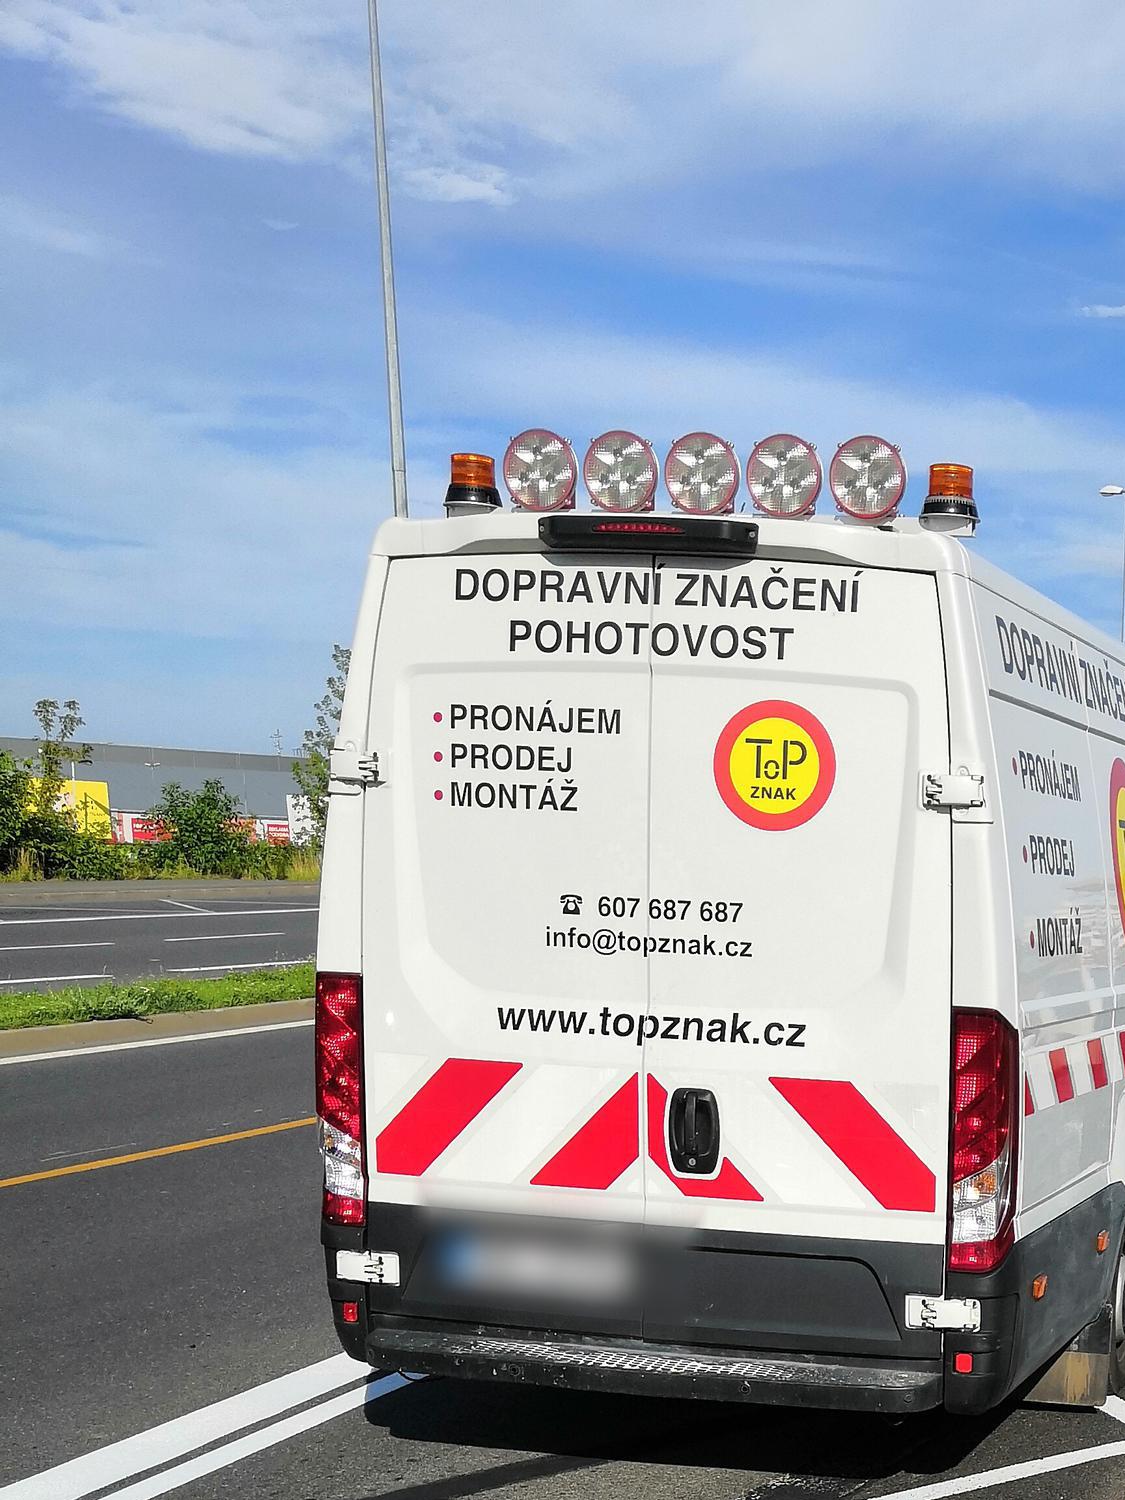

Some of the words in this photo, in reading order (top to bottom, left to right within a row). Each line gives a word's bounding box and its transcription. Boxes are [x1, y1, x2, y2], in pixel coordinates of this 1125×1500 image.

[454, 562, 662, 606] DOPRAVNÍ
[673, 567, 863, 613] ZNAČENÍ
[509, 619, 794, 660] POHOTOVOST
[995, 614, 1083, 704] DOPRAVNÍ
[449, 700, 622, 735] PRONÁJEM
[449, 744, 573, 774] PRODEJ
[1018, 749, 1082, 802] PRONÁJEM
[449, 781, 578, 812] MONTÁŽ
[749, 785, 796, 801] ZNAK
[1029, 834, 1075, 877] PRODEJ
[597, 896, 641, 919] 607
[647, 898, 691, 922] 687
[698, 900, 743, 924] 687
[545, 926, 754, 958] info@topznak.cz
[1036, 907, 1083, 957] MONTÁŽ
[497, 1005, 807, 1048] www.topznak.cz
